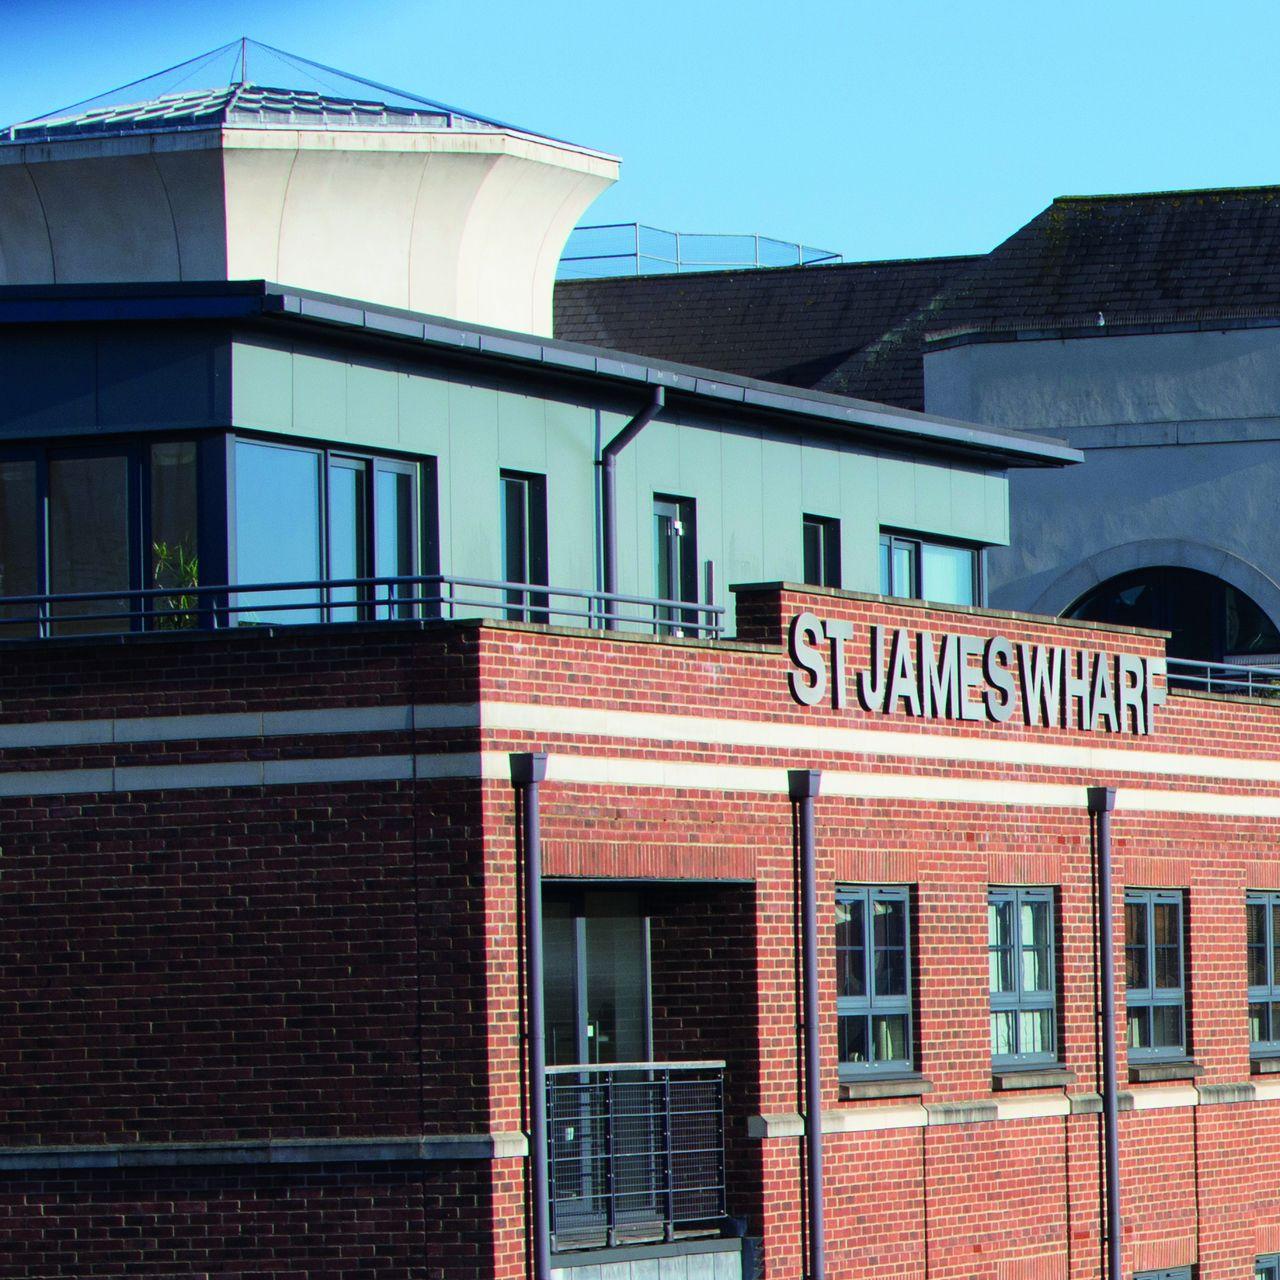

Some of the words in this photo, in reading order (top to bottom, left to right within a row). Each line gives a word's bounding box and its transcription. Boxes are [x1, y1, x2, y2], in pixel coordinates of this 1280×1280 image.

[788, 611, 853, 709] ST
[856, 624, 1017, 723] JAMES
[1018, 643, 1167, 736] WHARF
